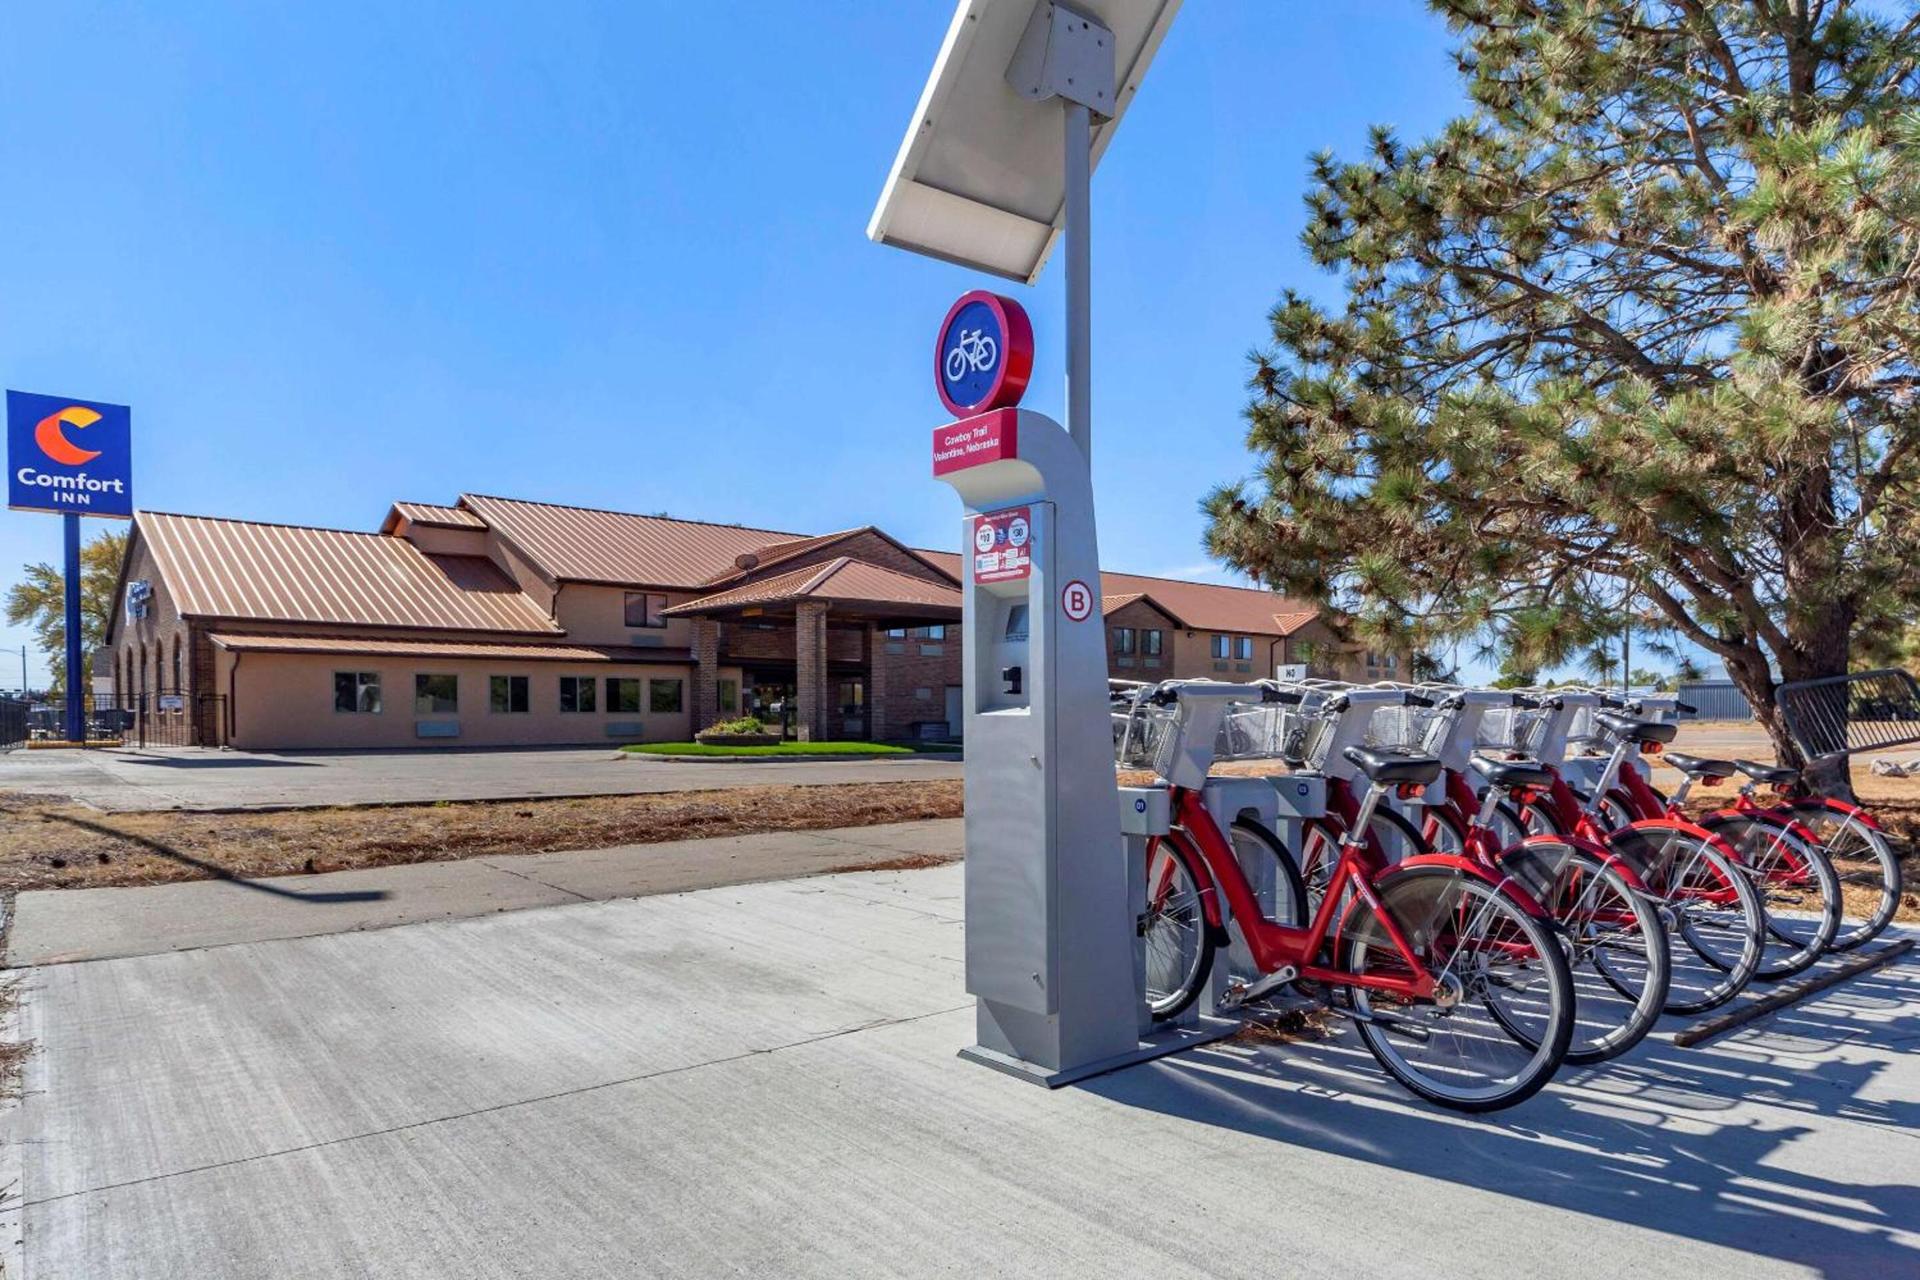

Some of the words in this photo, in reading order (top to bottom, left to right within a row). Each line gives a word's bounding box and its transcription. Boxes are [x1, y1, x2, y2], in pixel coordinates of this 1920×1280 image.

[945, 432, 972, 446] Cowboy
[973, 425, 988, 438] Trail
[966, 438, 999, 453] Nebraska
[18, 468, 124, 494] Comfort
[53, 491, 91, 505] INN
[1071, 591, 1084, 611] B
[1136, 802, 1144, 810] 01
